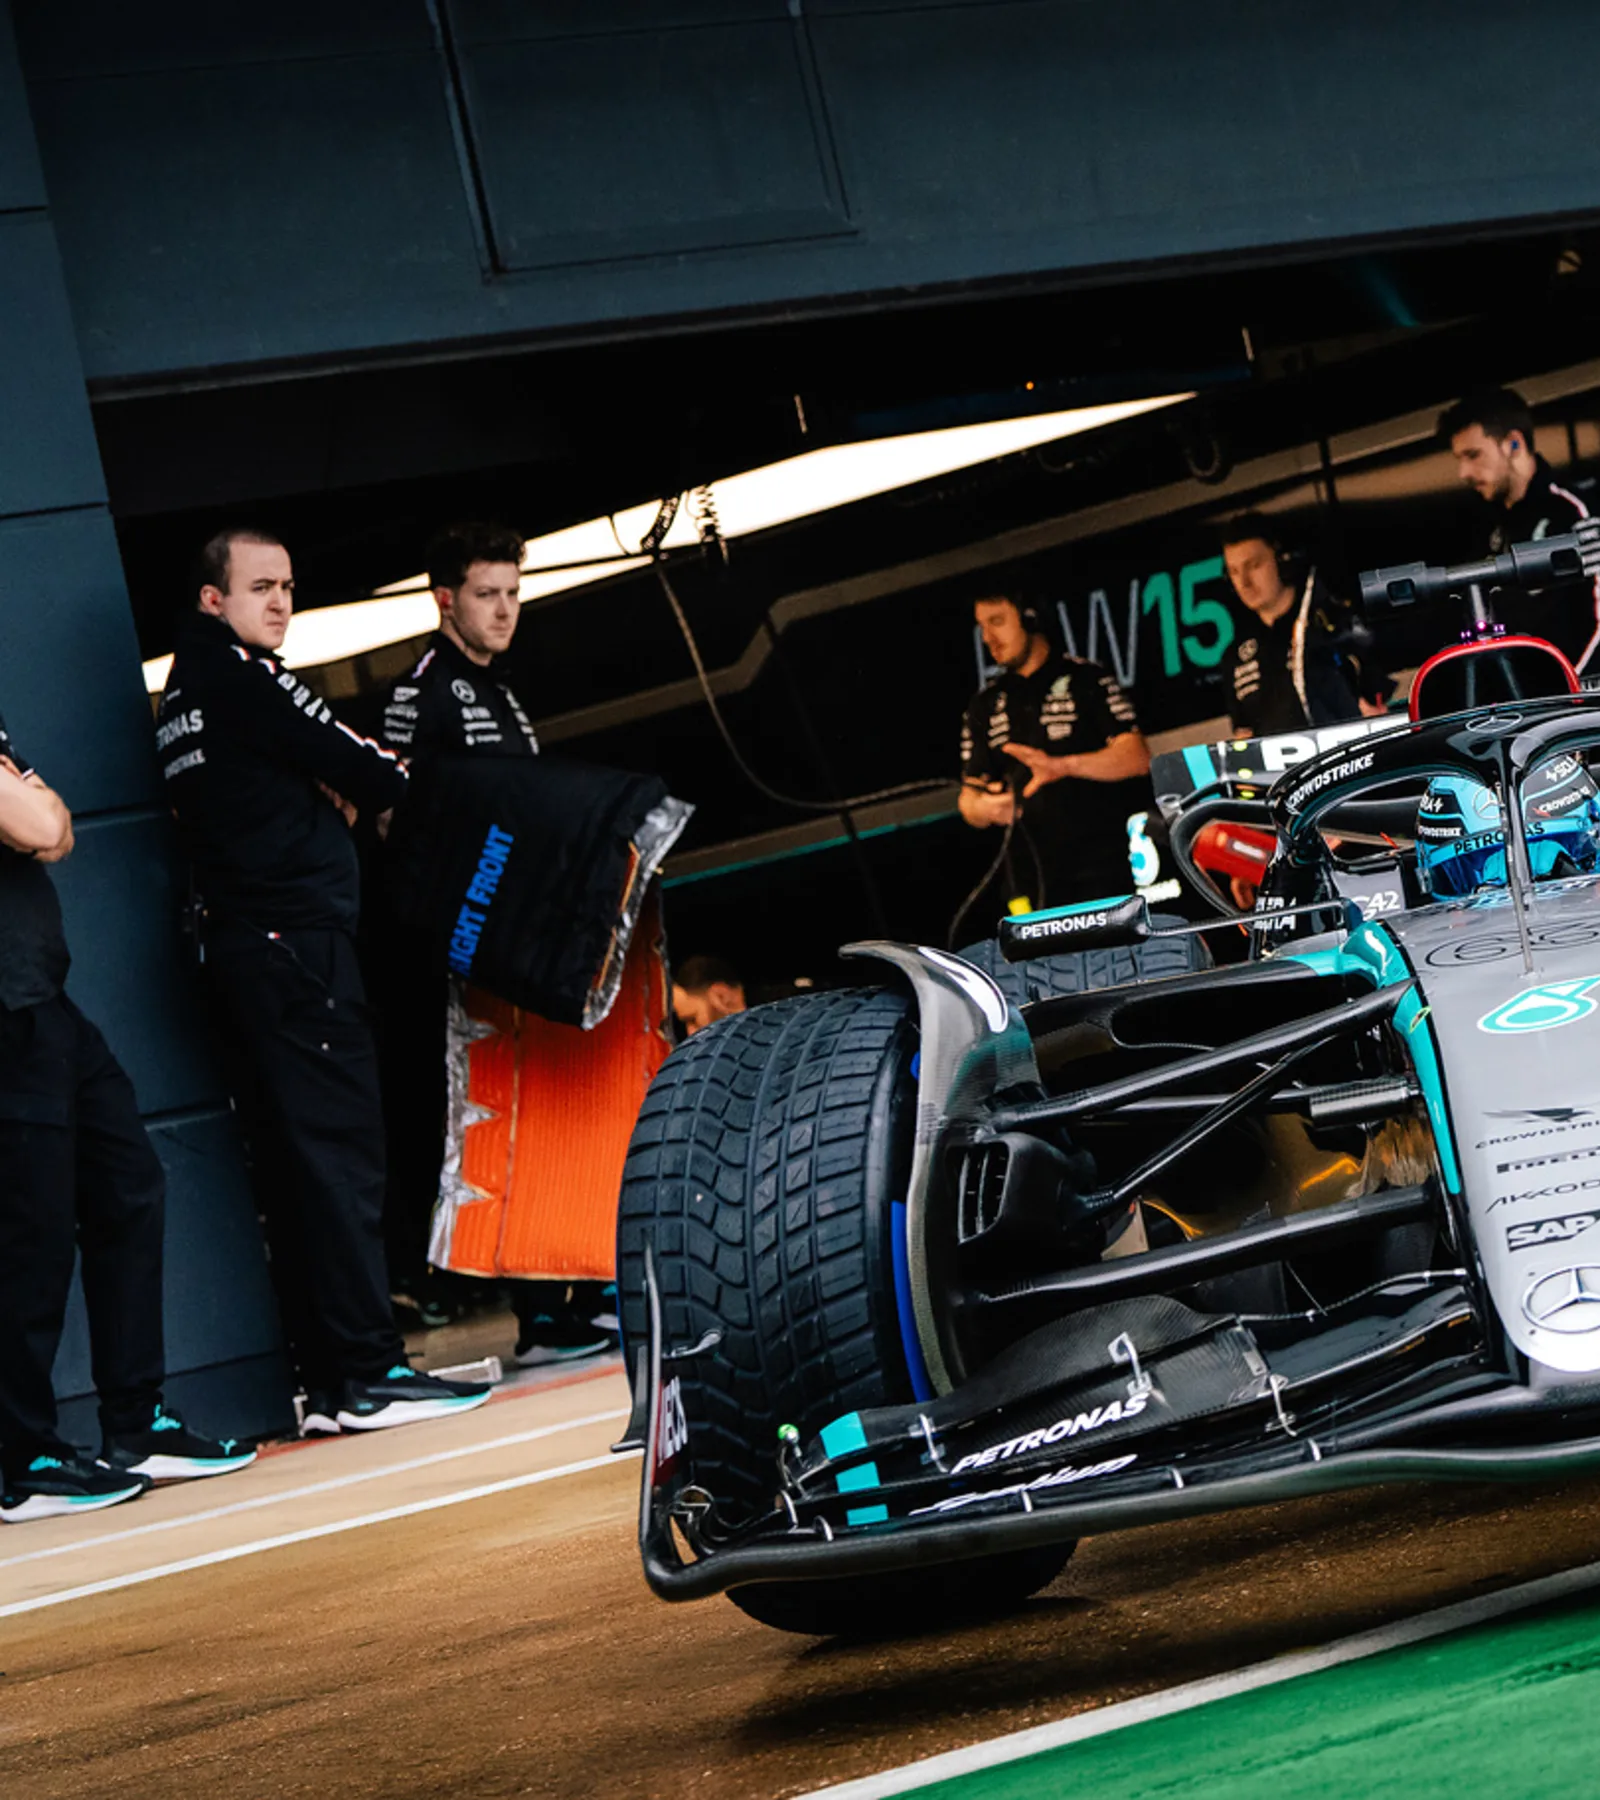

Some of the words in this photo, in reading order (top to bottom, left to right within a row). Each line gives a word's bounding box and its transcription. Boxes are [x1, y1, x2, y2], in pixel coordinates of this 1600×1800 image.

[466, 823, 514, 906] FRONT
[1021, 912, 1107, 940] PETRONAS
[1507, 1213, 1597, 1250] SAP
[951, 1391, 1149, 1475] PETRONAS
